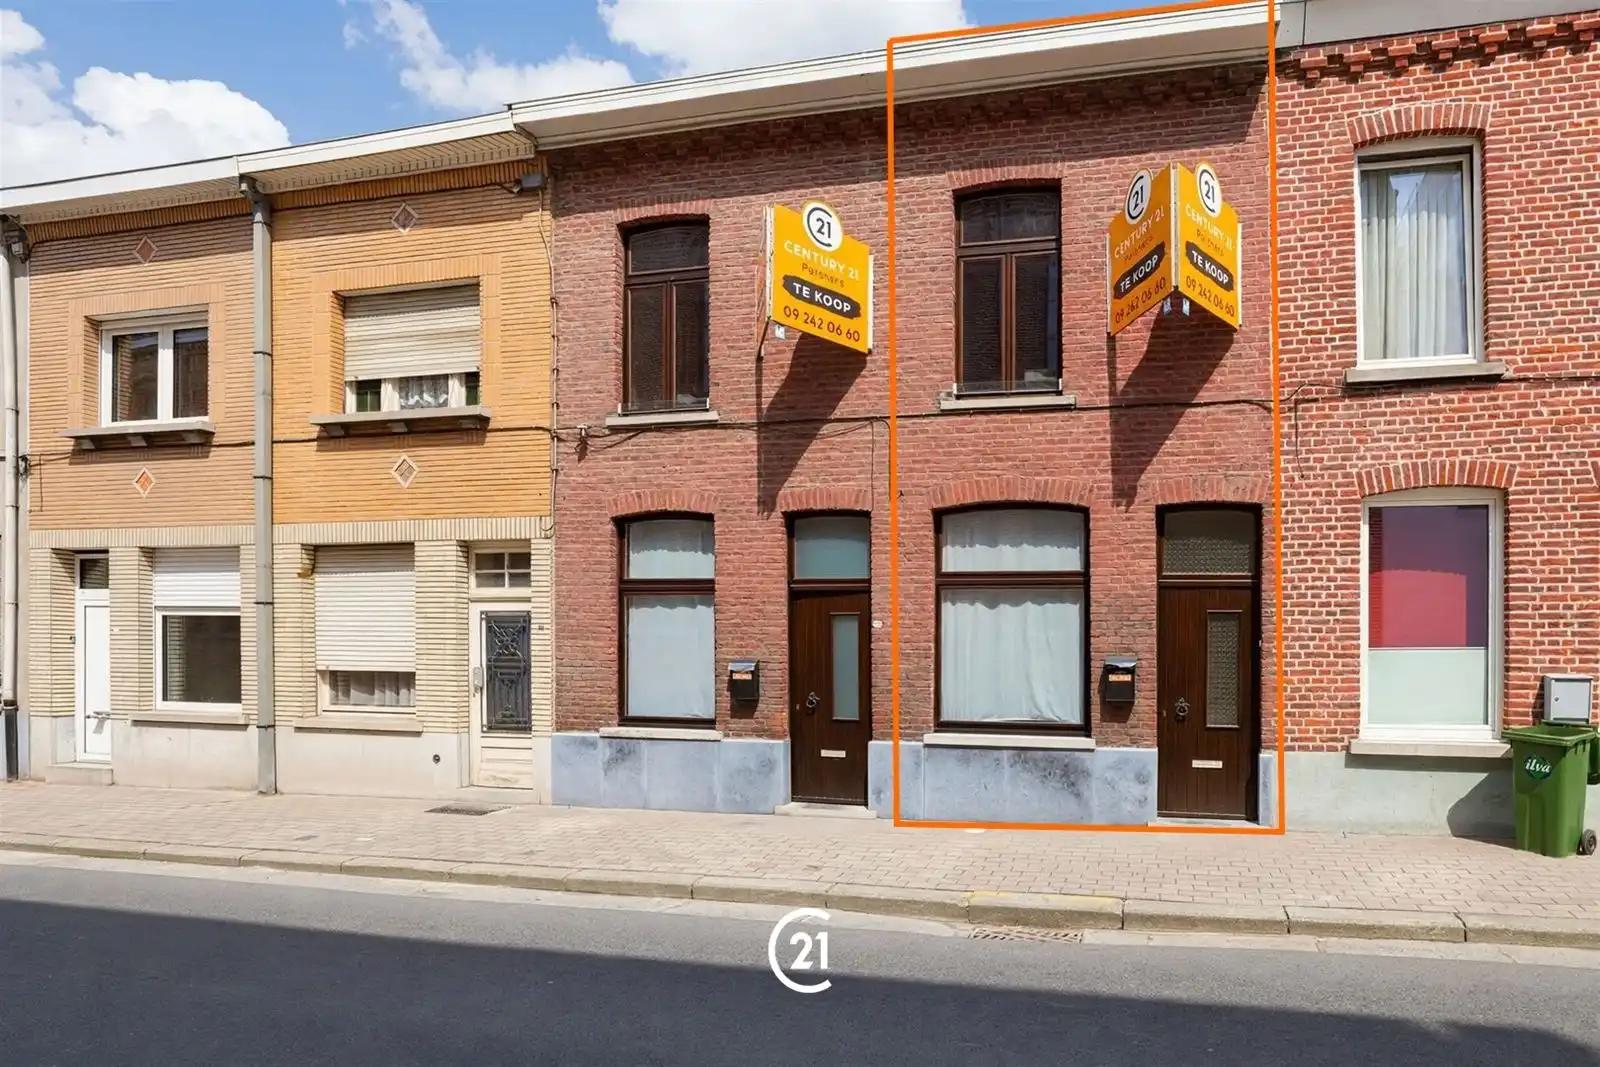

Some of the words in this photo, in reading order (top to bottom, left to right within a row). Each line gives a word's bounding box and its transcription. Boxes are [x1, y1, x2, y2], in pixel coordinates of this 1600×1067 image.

[1133, 185, 1144, 211] 21
[1204, 180, 1215, 203] 21
[815, 217, 832, 239] 21
[1114, 213, 1154, 258] CENTURY
[1155, 204, 1165, 222] 21
[1185, 203, 1224, 241] CENTURY
[784, 239, 846, 274] CENTURY
[848, 266, 860, 280] 21
[1120, 276, 1131, 293] TE
[1133, 254, 1159, 283] KOOP
[1191, 250, 1203, 268] TE
[1205, 260, 1229, 286] KOOP
[793, 281, 811, 298] TE
[815, 288, 851, 313] KOOP
[1115, 308, 1124, 323] 09
[1155, 276, 1166, 294] 60
[1186, 275, 1197, 291] 09
[783, 305, 799, 320] 09
[803, 312, 823, 330] 242
[827, 321, 842, 336] 06
[846, 328, 860, 342] 60
